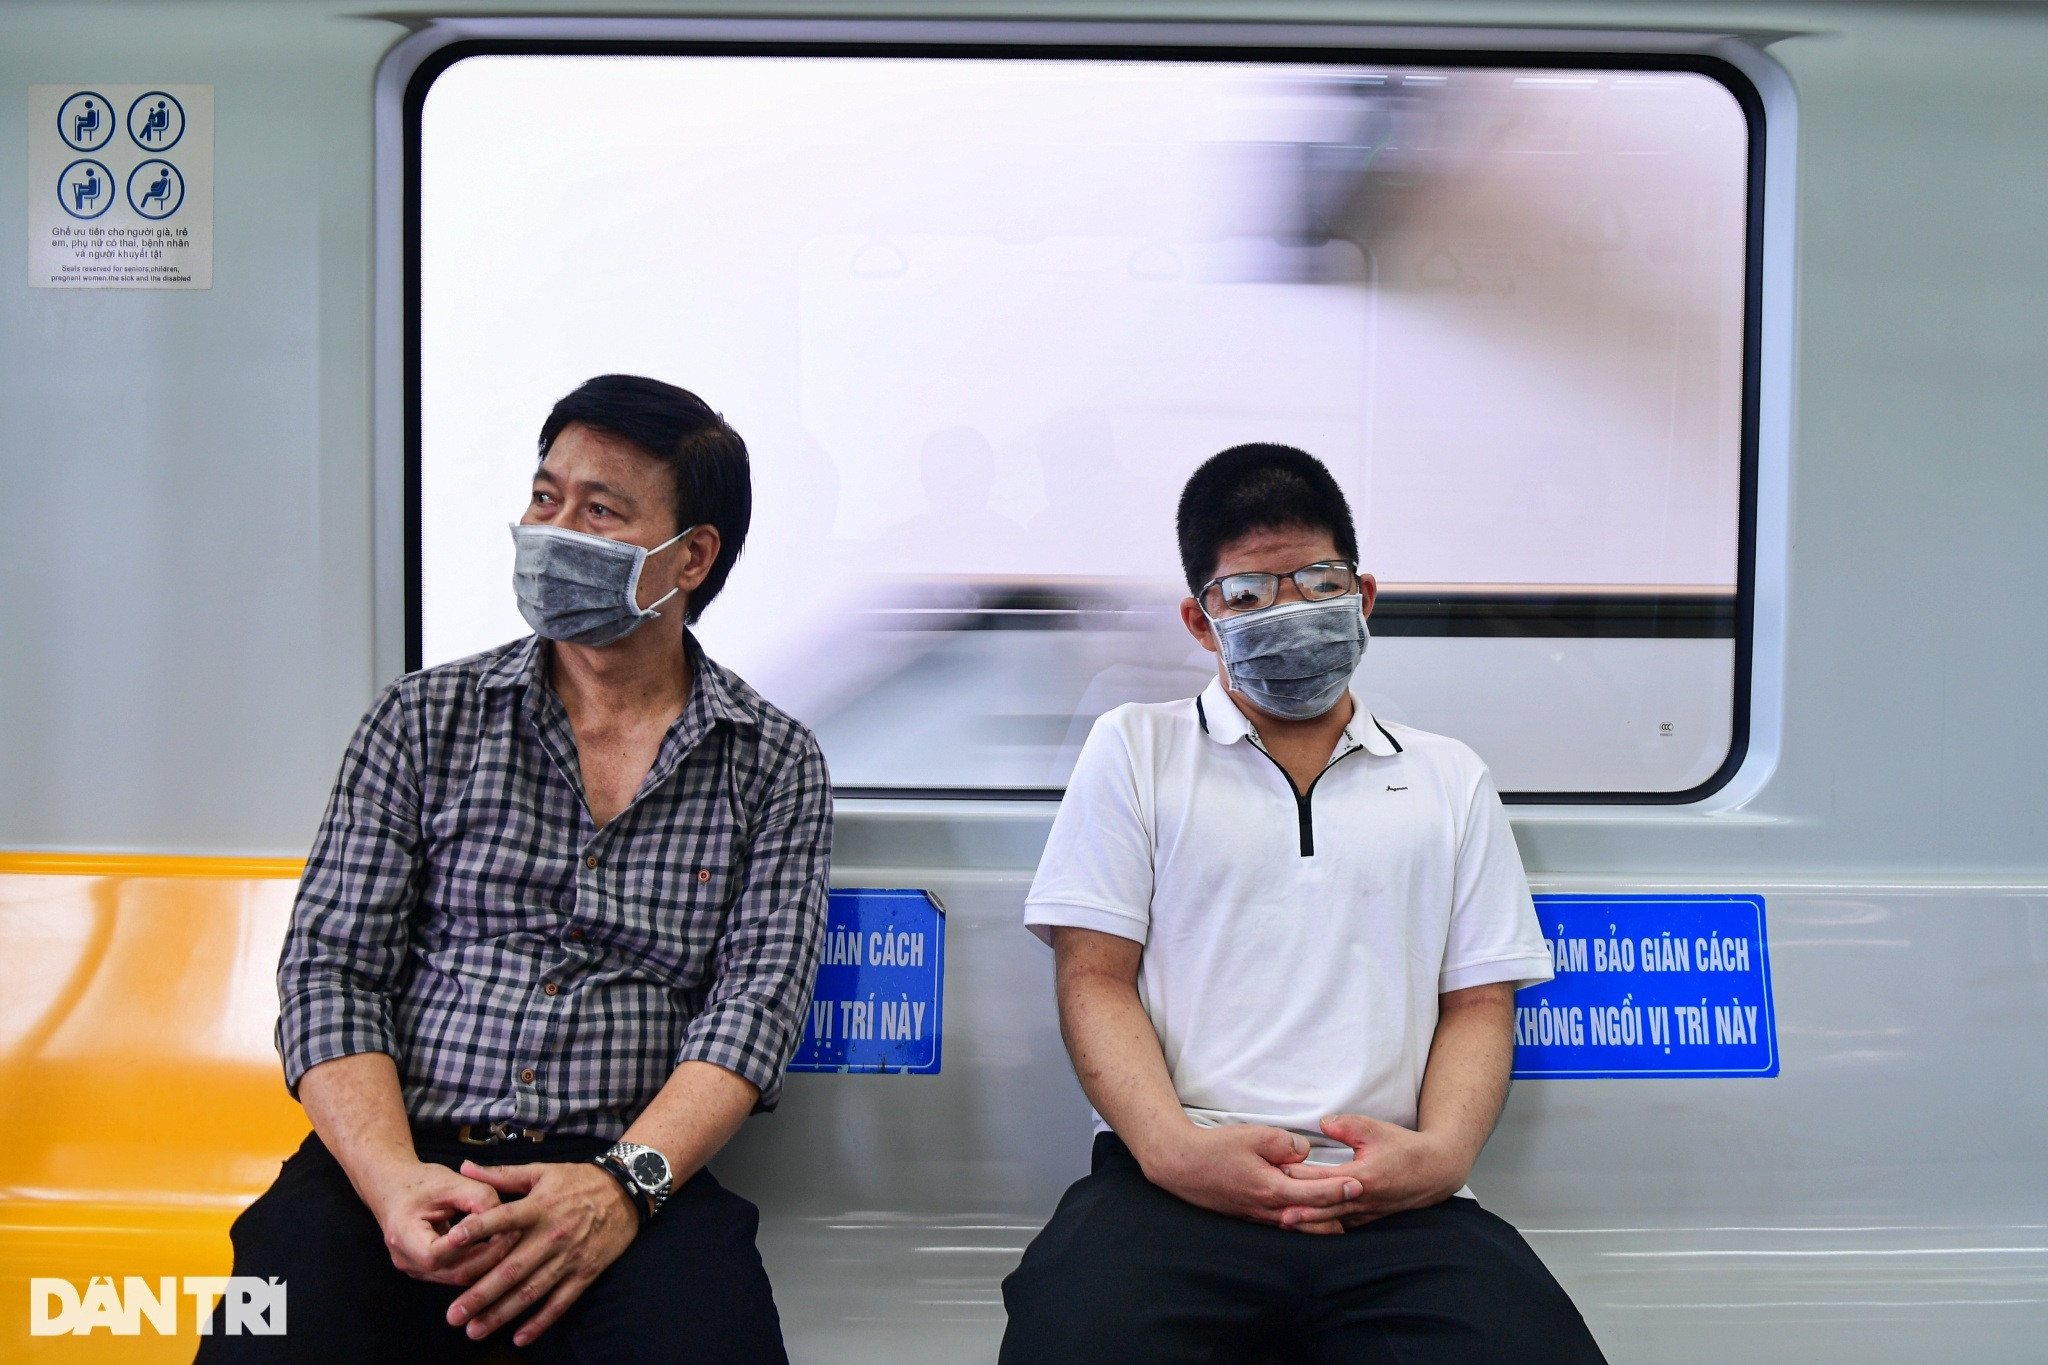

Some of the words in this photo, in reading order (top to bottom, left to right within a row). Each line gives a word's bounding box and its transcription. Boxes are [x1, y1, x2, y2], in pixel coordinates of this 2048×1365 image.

[52, 226, 71, 236] Ghế
[73, 228, 86, 236] ưu
[88, 227, 105, 236] tiên
[107, 228, 125, 236] cho
[127, 228, 154, 238] người
[156, 227, 173, 238] già,
[175, 227, 188, 236] trẻ
[71, 239, 88, 249] phụ
[105, 239, 117, 247] có
[119, 240, 139, 248] thai,
[141, 240, 164, 248] bệnh
[75, 249, 86, 258] và
[88, 249, 116, 259] người
[117, 248, 148, 260] khuyết
[150, 250, 162, 259] tật
[51, 275, 81, 283] pregnant
[869, 925, 924, 967] CÁCH
[1593, 923, 1635, 972] BẢO
[1641, 932, 1690, 972] GIÃN
[1695, 930, 1750, 972] CÁCH
[813, 1000, 834, 1049] VỊ
[840, 992, 875, 1040] TRÍ
[880, 992, 926, 1041] NÀY
[1589, 993, 1643, 1046] NGỒI
[1647, 1006, 1671, 1055] VỊ
[1674, 997, 1710, 1045] TRÍ
[1715, 997, 1758, 1045] NÀY
